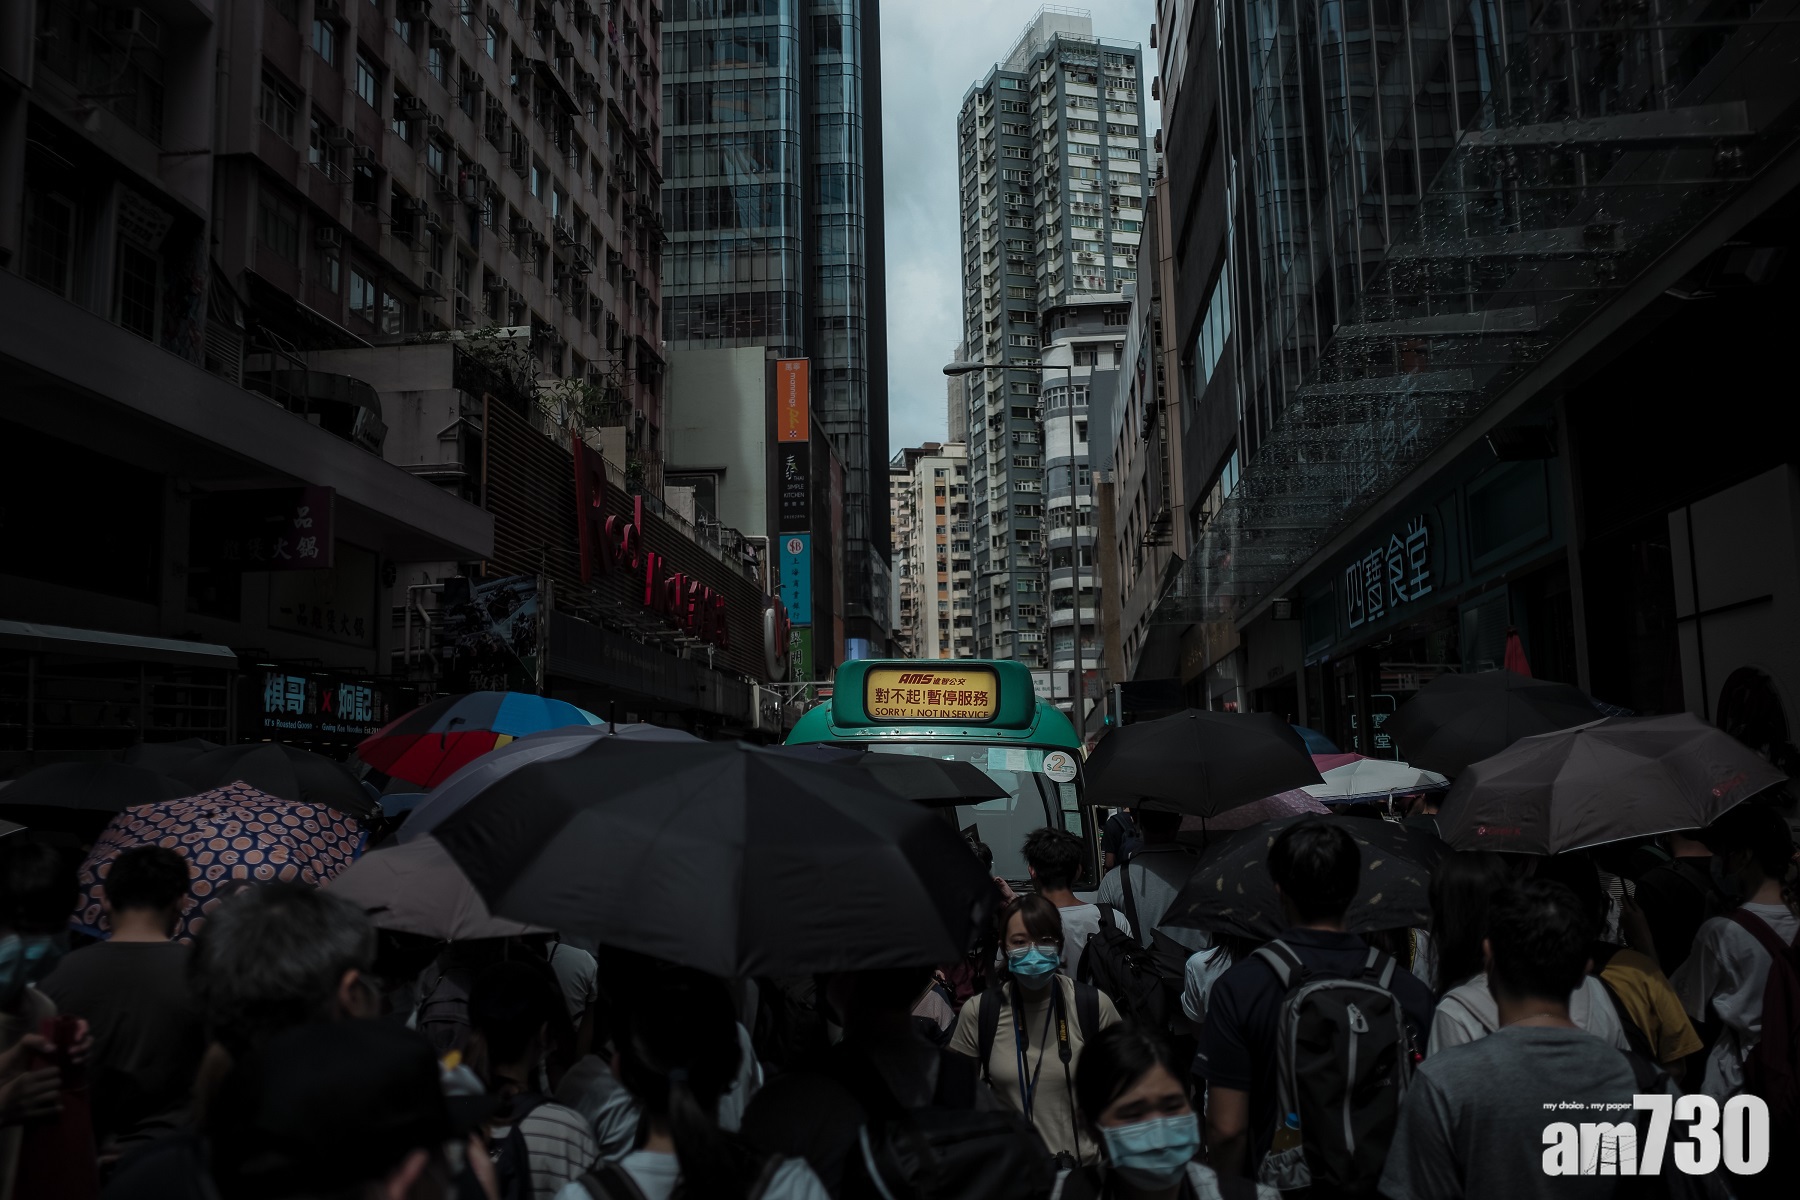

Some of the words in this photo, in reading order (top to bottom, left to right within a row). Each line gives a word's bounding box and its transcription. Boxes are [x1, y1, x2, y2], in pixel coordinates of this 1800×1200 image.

[1346, 514, 1433, 629] 四寶食堂
[899, 673, 934, 684] AMS
[264, 671, 306, 716] 棋哥
[876, 708, 906, 717] SORRY
[917, 709, 938, 718] NOT
[940, 710, 951, 719] IN
[952, 711, 989, 719] SERVICE
[276, 719, 297, 729] Roasted
[297, 720, 313, 730] Goose
